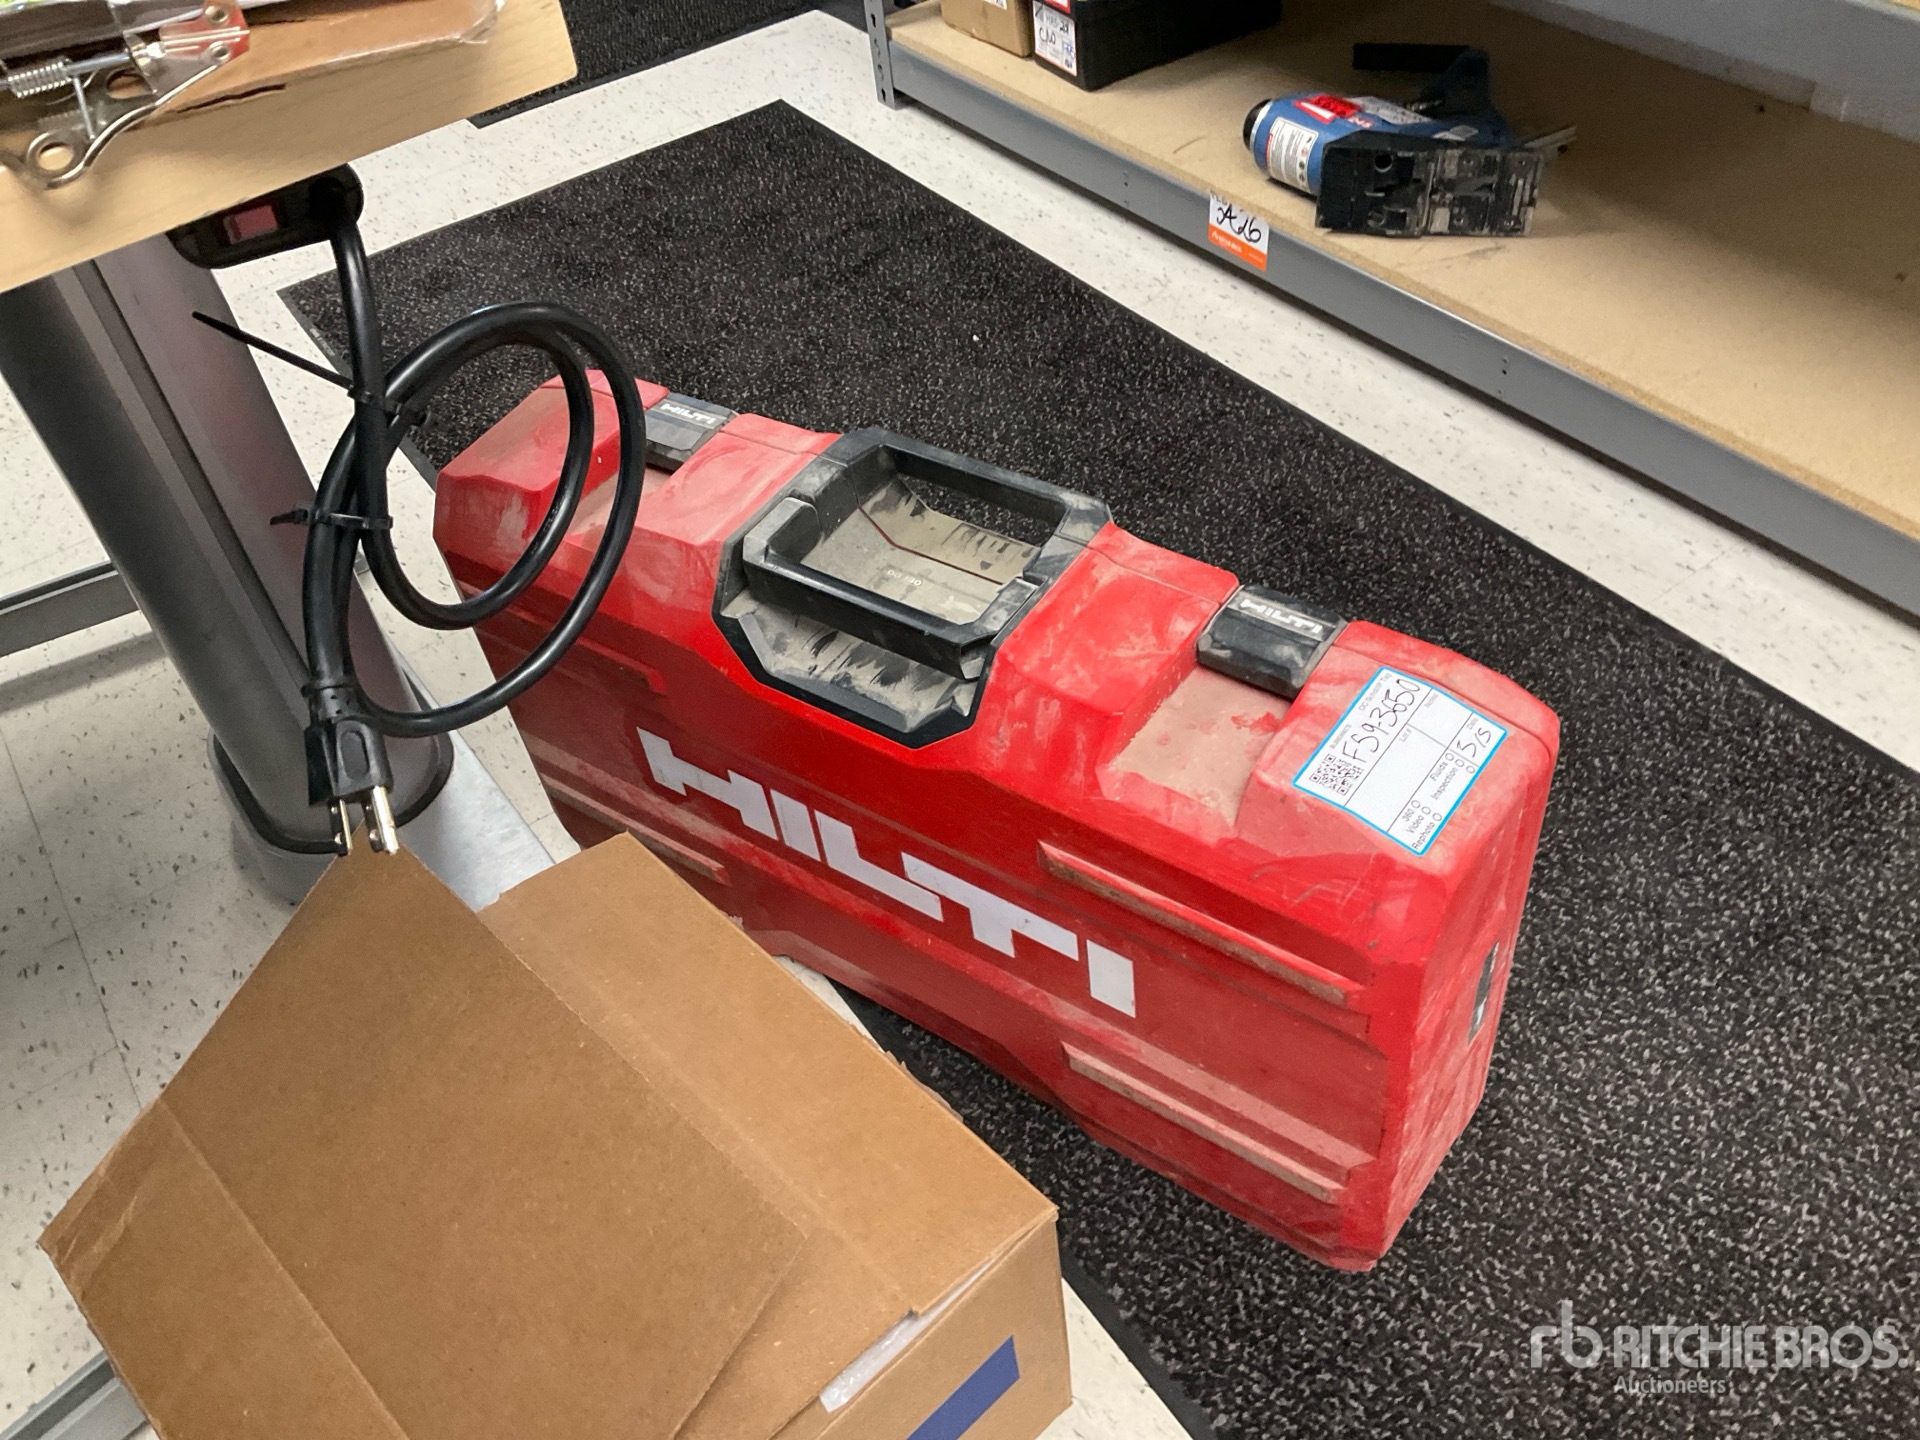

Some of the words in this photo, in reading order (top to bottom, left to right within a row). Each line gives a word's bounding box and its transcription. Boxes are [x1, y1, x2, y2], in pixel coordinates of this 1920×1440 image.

[660, 403, 716, 425] HILTI
[1240, 599, 1323, 633] HILTI
[1429, 760, 1448, 781] Fluids
[1430, 765, 1459, 800] Inspection
[1406, 813, 1424, 834] Video
[1411, 821, 1437, 850] Rephoto
[637, 727, 1135, 1018] HILTI
